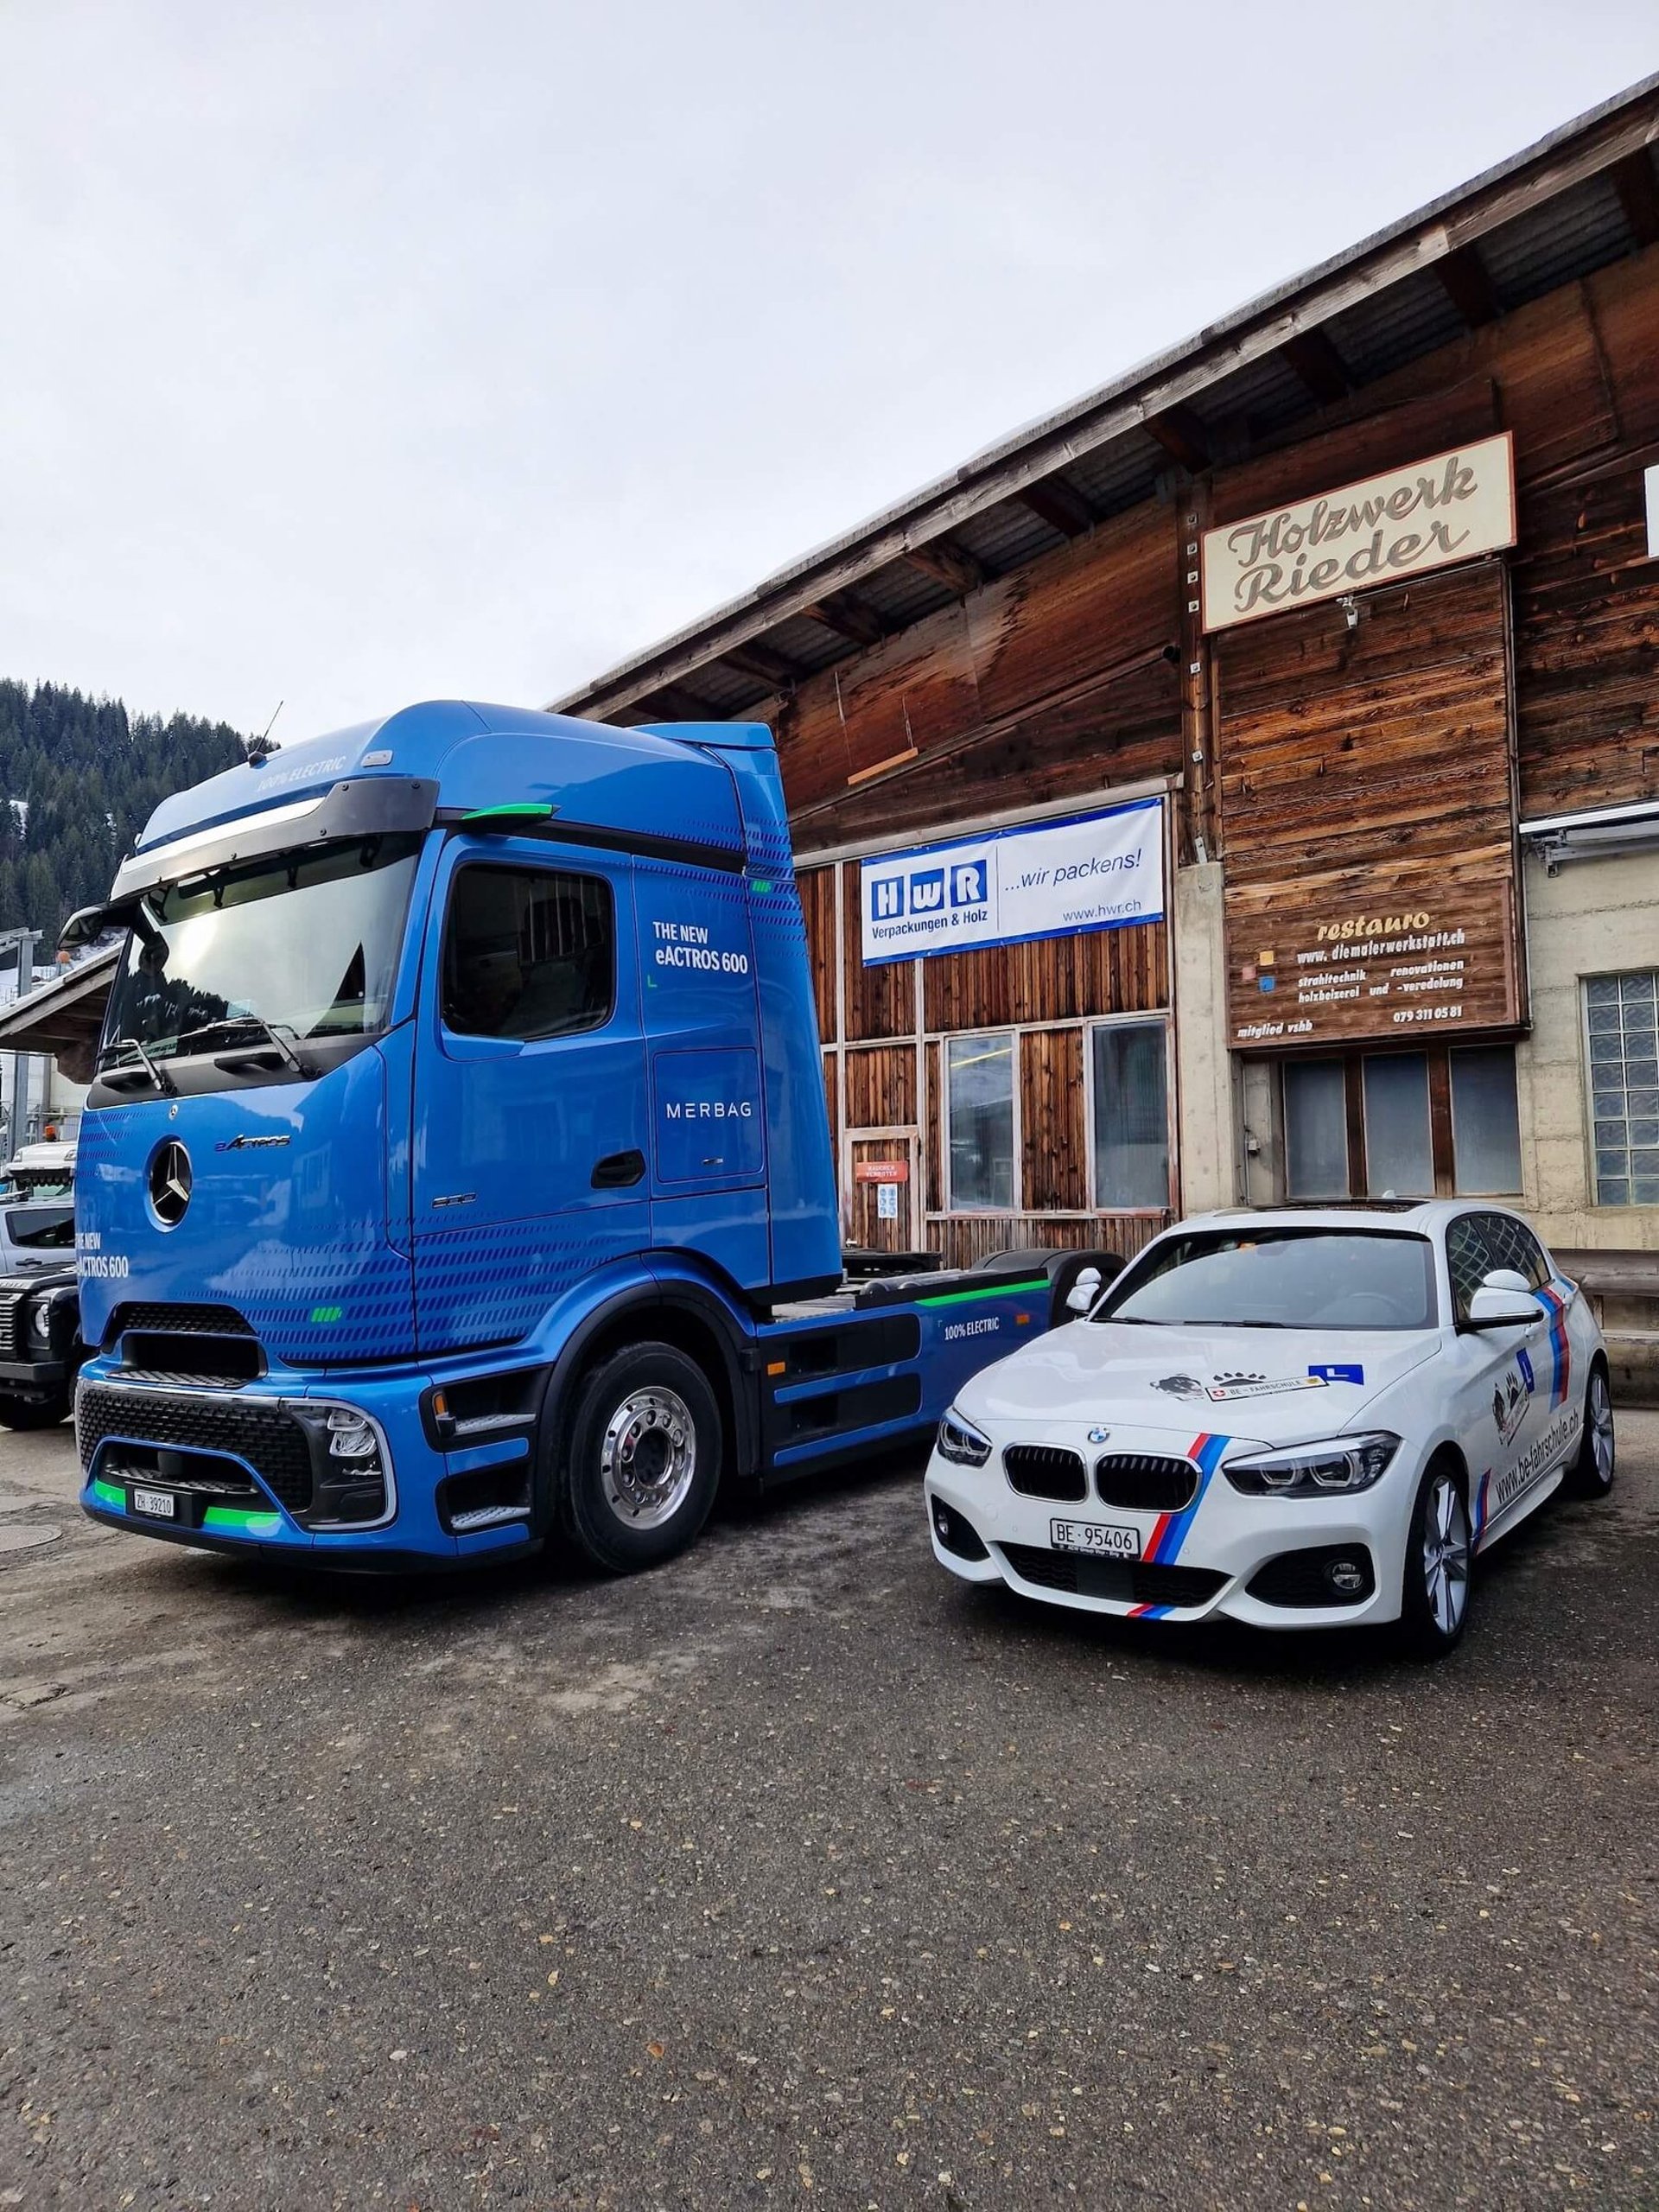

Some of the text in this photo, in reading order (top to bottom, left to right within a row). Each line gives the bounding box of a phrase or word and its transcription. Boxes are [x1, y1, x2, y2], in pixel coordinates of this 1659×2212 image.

[1228, 456, 1478, 568] Holzwerk
[1234, 520, 1470, 613] Rieder
[289, 755, 346, 781] ELECTRIC
[1052, 849, 1141, 887] packens!
[1063, 899, 1141, 921] www.hwr.ch
[652, 921, 709, 944] THE NEW
[872, 909, 988, 939] Verpackungen & Holz
[1317, 911, 1430, 941] restauro
[1332, 928, 1465, 960] diemalerwerkstatt.ch
[656, 945, 748, 974] eACTROS 600
[1298, 960, 1465, 988] strahltechnik renovationen
[1299, 976, 1463, 1002] holzbeizerei und -veredelung
[1393, 1006, 1462, 1022] 079 311 05 81
[1237, 1020, 1313, 1039] mitglied vshb
[666, 1102, 752, 1119] MERBAG
[85, 1232, 101, 1249] NEW
[109, 1255, 129, 1278] 600
[944, 1317, 1000, 1340] 100% ELECTRIC
[1249, 1381, 1303, 1393] FAHRSCHULE
[1496, 1408, 1580, 1504] www.be-fahrschule.ch
[1057, 1523, 1133, 1549] BE 95406
